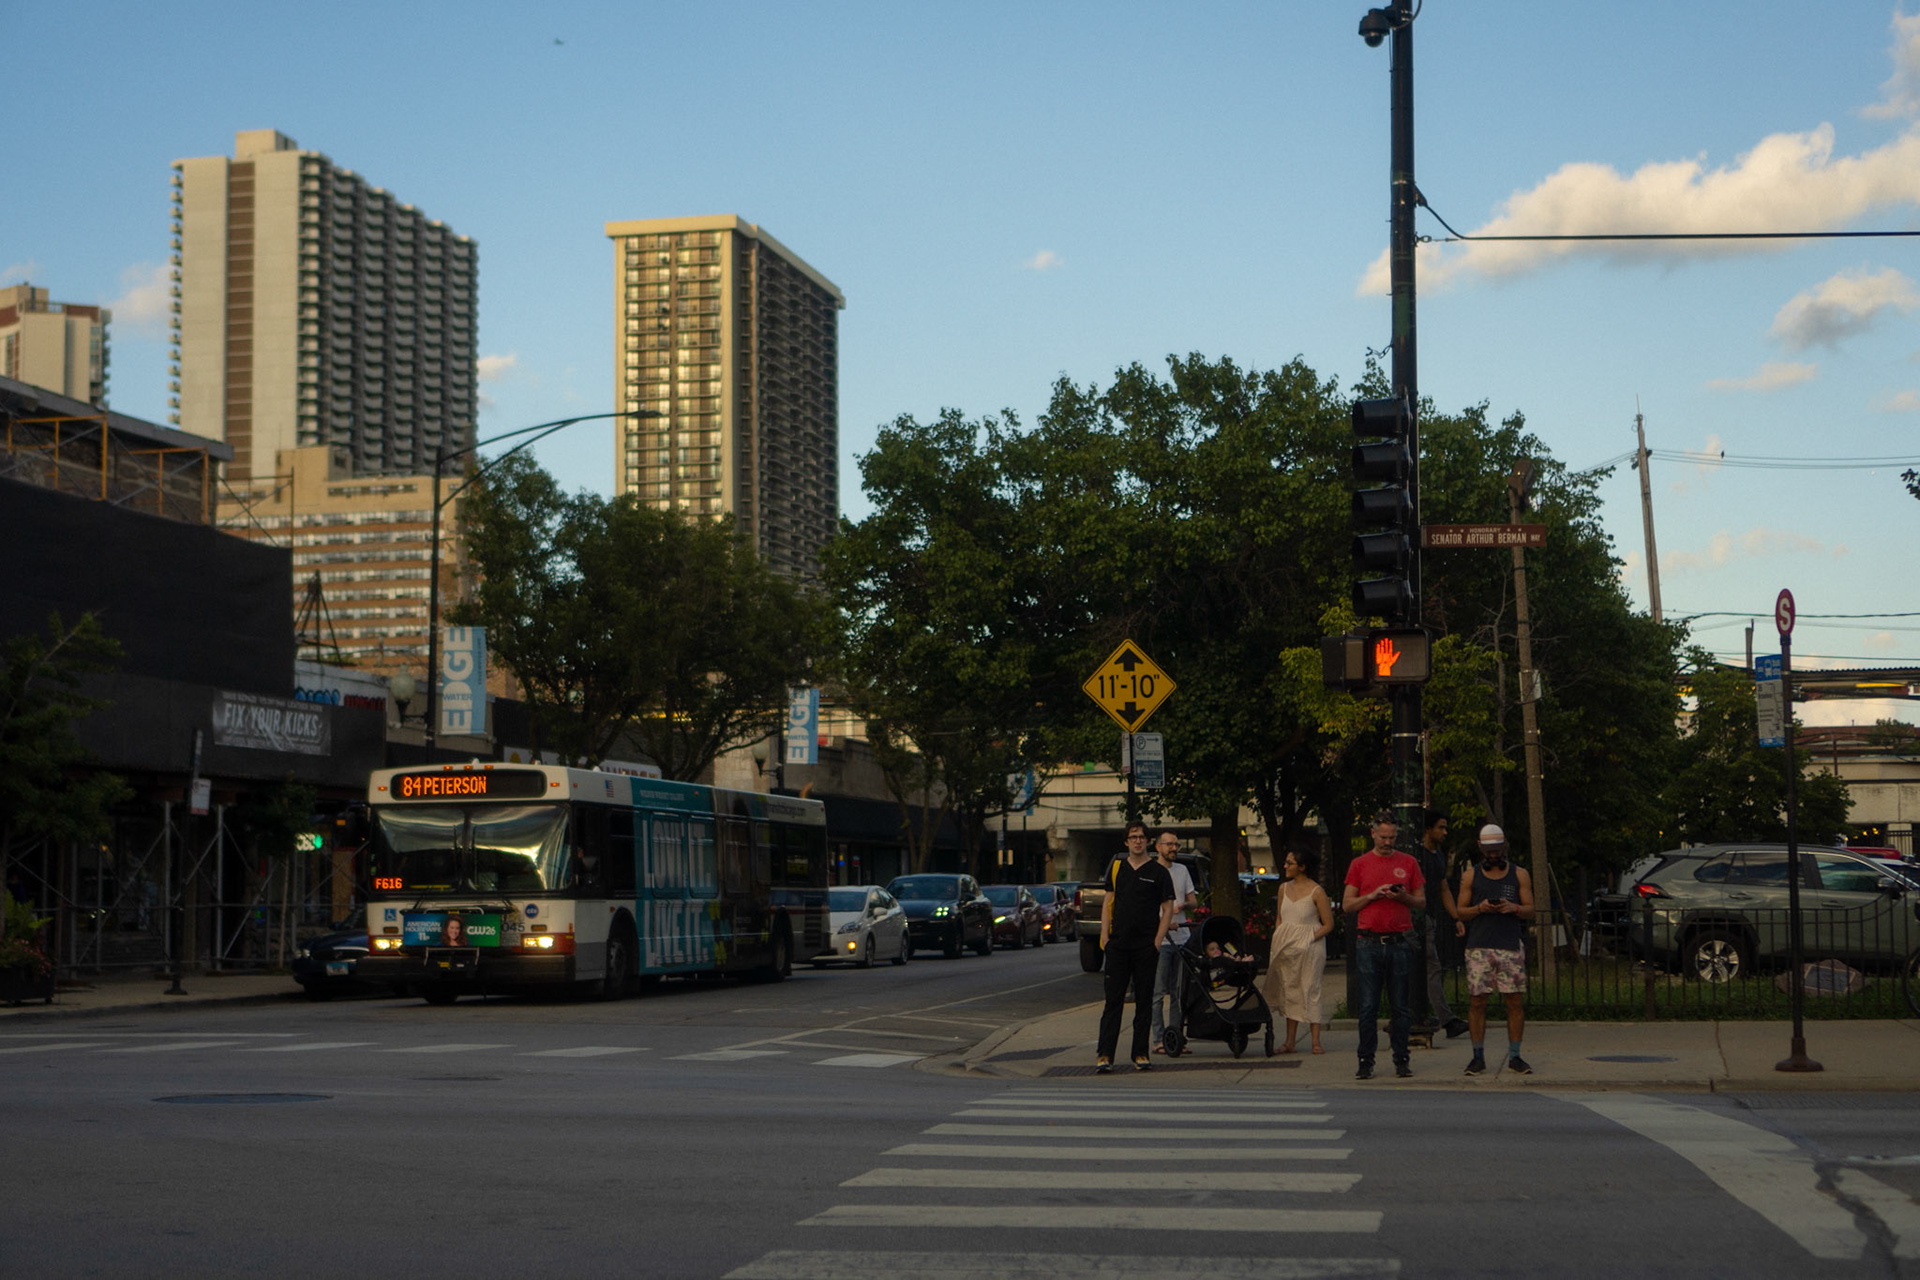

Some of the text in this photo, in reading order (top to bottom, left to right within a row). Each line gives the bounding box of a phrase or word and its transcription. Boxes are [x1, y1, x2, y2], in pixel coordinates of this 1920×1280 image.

[1431, 533, 1541, 545] SENATOR ARTHUR BERMAN WAY
[1779, 597, 1792, 631] S
[442, 627, 474, 731] EDGE
[442, 693, 473, 701] WATER
[224, 702, 319, 738] FIX YOUR KICKS
[403, 775, 488, 797] 84 PETERSON
[375, 878, 403, 891] F616
